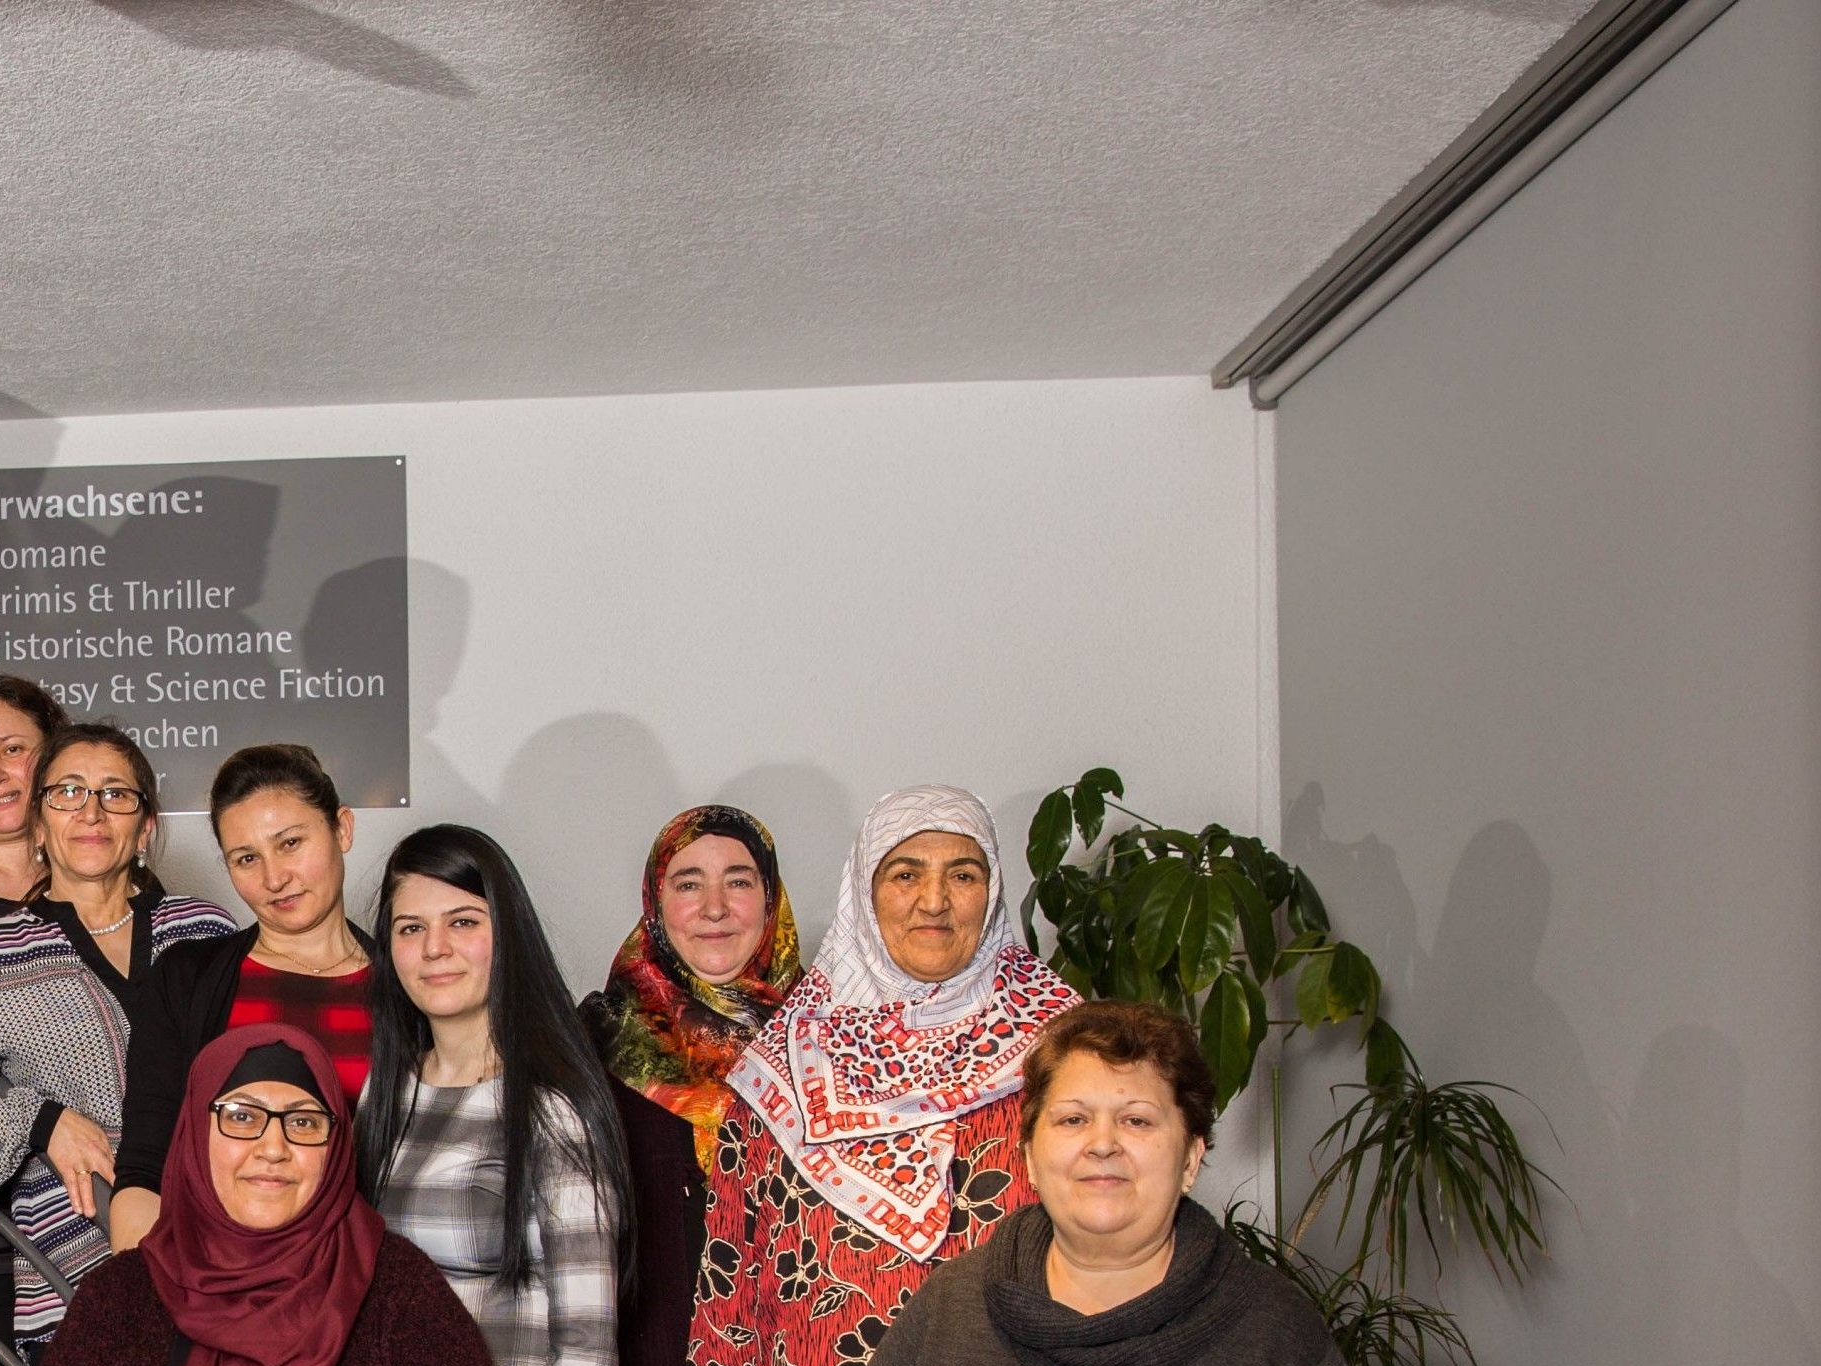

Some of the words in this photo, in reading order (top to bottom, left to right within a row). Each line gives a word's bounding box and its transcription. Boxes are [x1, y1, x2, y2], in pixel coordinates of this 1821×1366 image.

[88, 583, 114, 613] &
[123, 578, 236, 611] Thriller
[167, 626, 293, 656] Romane
[39, 680, 99, 711] tasy
[110, 674, 135, 704] &
[146, 672, 267, 704] Science
[280, 668, 385, 699] Fiction
[129, 719, 218, 750] achen
